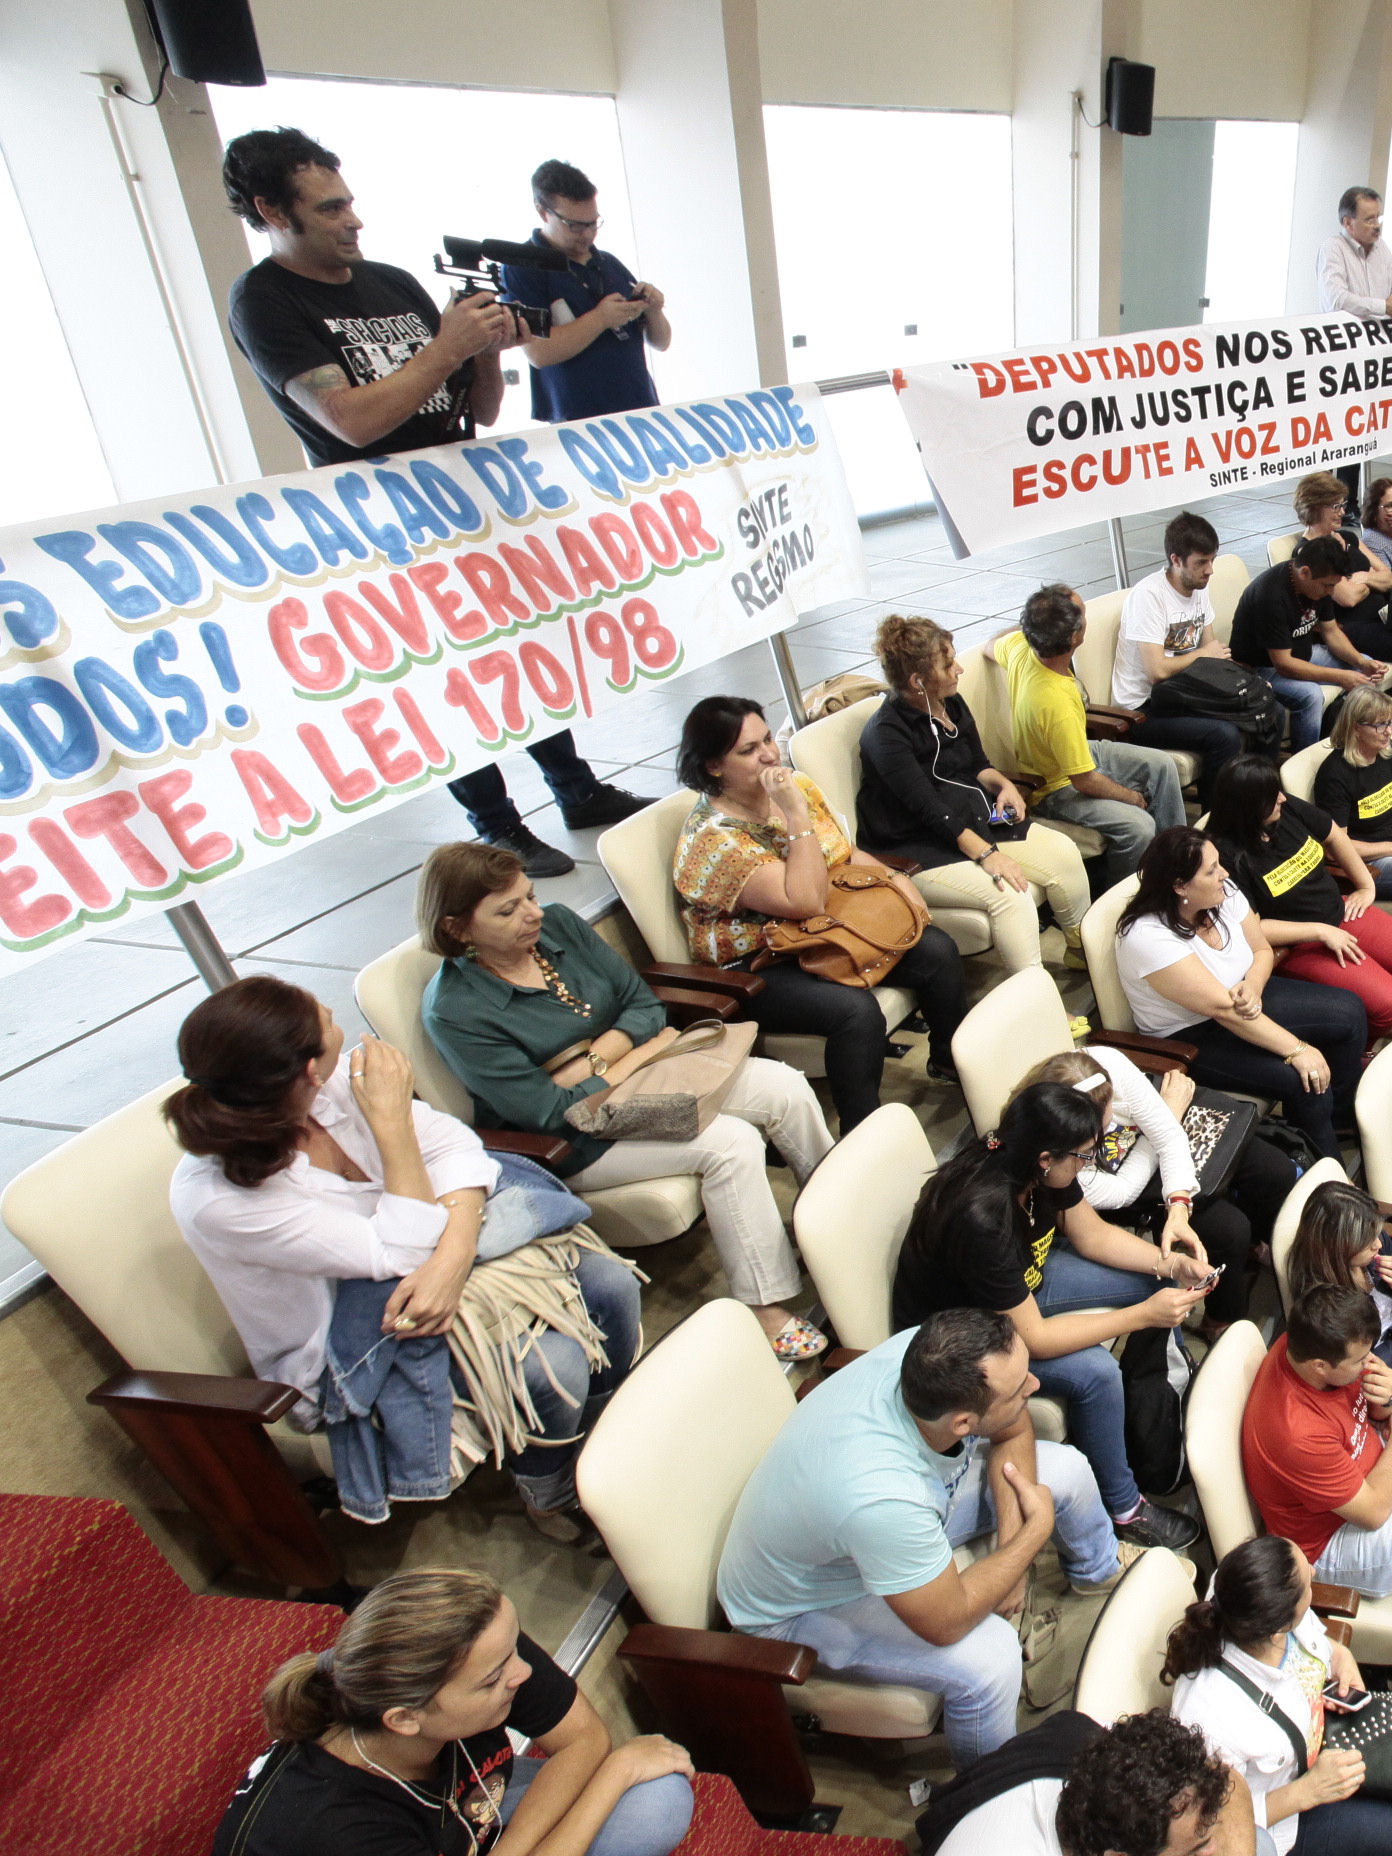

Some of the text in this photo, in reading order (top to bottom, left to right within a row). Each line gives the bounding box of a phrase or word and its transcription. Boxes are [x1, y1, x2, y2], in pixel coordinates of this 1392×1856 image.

[336, 312, 432, 345] SPECIALS
[1215, 329, 1293, 369] NOS
[1026, 395, 1124, 447] COM
[1130, 376, 1275, 430] JUSTIÇA
[1286, 370, 1307, 405] E
[33, 456, 486, 620] EDUCAÇÃO
[462, 437, 570, 519] DE
[558, 385, 817, 500] QUALIDADE
[1012, 441, 1175, 508] ESCUTE
[1184, 436, 1206, 472] A
[1211, 421, 1281, 464] VOZ
[1290, 412, 1334, 449] DA
[1209, 466, 1249, 488] SINTE
[1260, 453, 1317, 477] Regional
[1320, 439, 1378, 464] Araranguá
[267, 489, 718, 692] GOVERNADOR
[229, 748, 314, 836] A
[296, 686, 447, 803] LEI
[443, 597, 678, 741] 170/98
